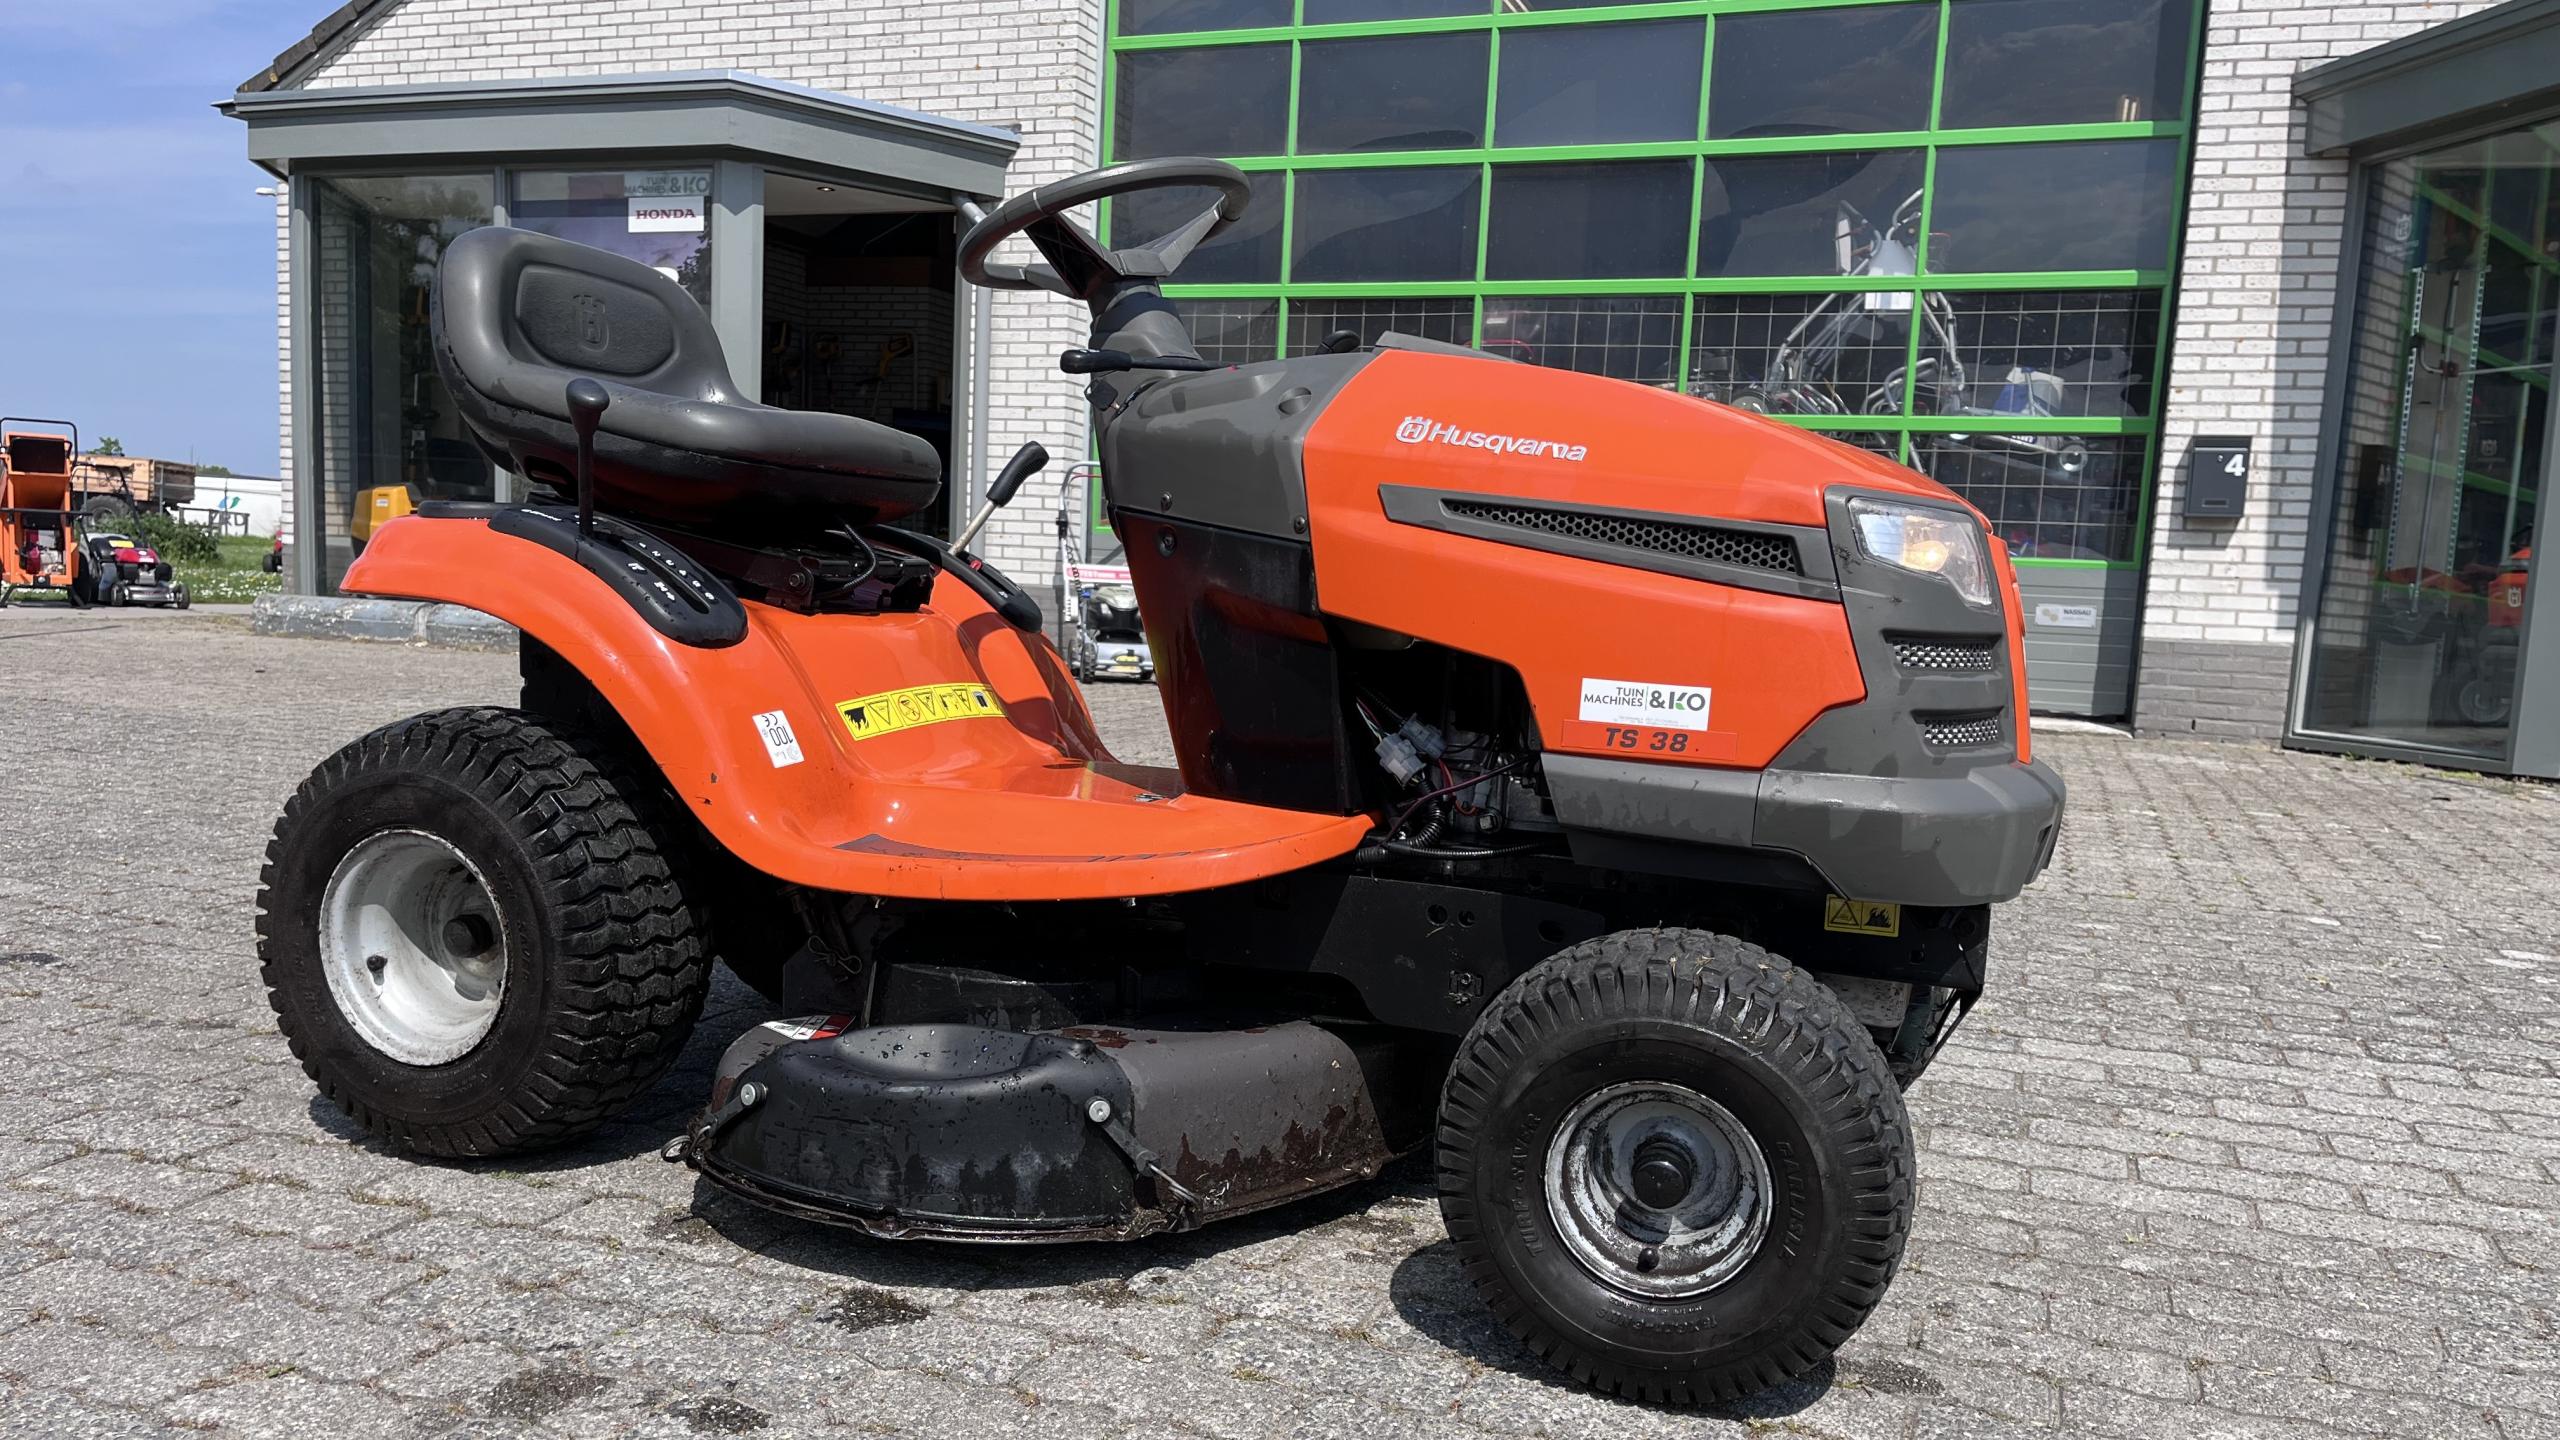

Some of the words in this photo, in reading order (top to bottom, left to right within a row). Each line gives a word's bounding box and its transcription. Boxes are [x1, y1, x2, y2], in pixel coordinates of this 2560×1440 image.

[636, 208, 696, 220] HONDA
[1428, 422, 1588, 461] Husqvarna
[2224, 453, 2246, 477] 4
[1583, 693, 1643, 707] MACHINES
[1616, 687, 1644, 697] TUIN
[1606, 727, 1638, 747] TS
[1650, 731, 1688, 752] 38
